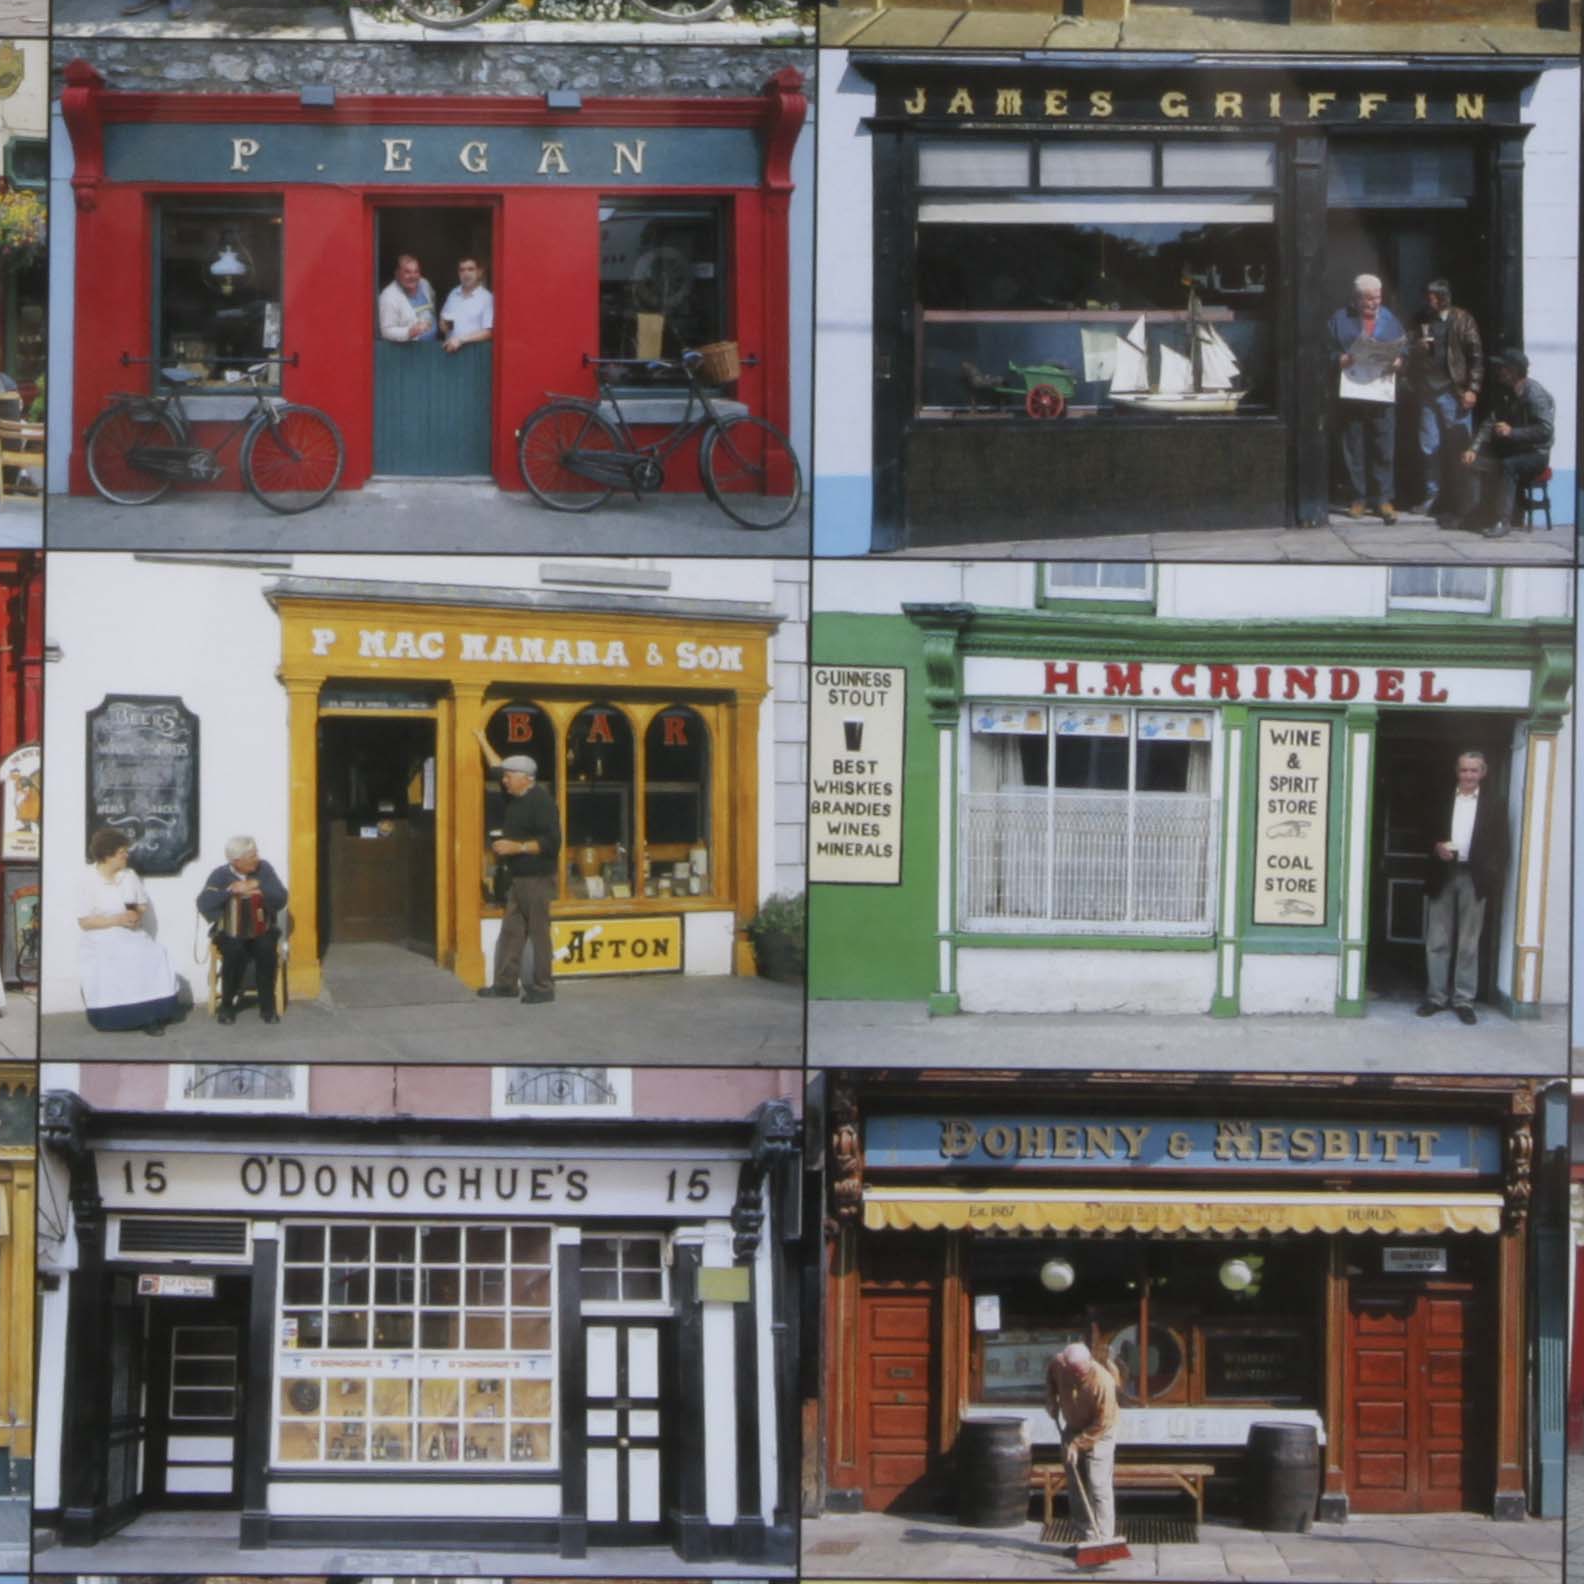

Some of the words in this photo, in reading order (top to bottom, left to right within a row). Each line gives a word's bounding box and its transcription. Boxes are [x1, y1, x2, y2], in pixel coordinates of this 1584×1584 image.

[904, 87, 1115, 118] JAMES
[1161, 91, 1486, 121] GRIFFIN
[383, 138, 647, 175] EGAN
[311, 629, 335, 655] P
[359, 630, 444, 658] MAC
[647, 644, 663, 666] &
[676, 643, 743, 671] SON
[816, 671, 892, 688] GUINNESS
[828, 690, 888, 707] STOUT
[1270, 727, 1322, 747] WINE
[833, 760, 879, 775] BEST
[1286, 752, 1301, 770] &
[814, 781, 893, 796] WHISKIES
[1270, 775, 1319, 794] SPIRIT
[811, 800, 891, 817] BRANDIES
[1267, 797, 1317, 816] STORE
[827, 821, 880, 837] WINES
[817, 843, 893, 858] MINERALS
[1267, 853, 1314, 871] COAL
[1265, 876, 1317, 895] STORE
[565, 931, 670, 964] AFTON
[940, 1120, 1150, 1160] DOHENY
[1167, 1131, 1194, 1158] &
[1215, 1120, 1441, 1164] NESBITT
[124, 1160, 167, 1194] 15
[667, 1169, 711, 1202] 15
